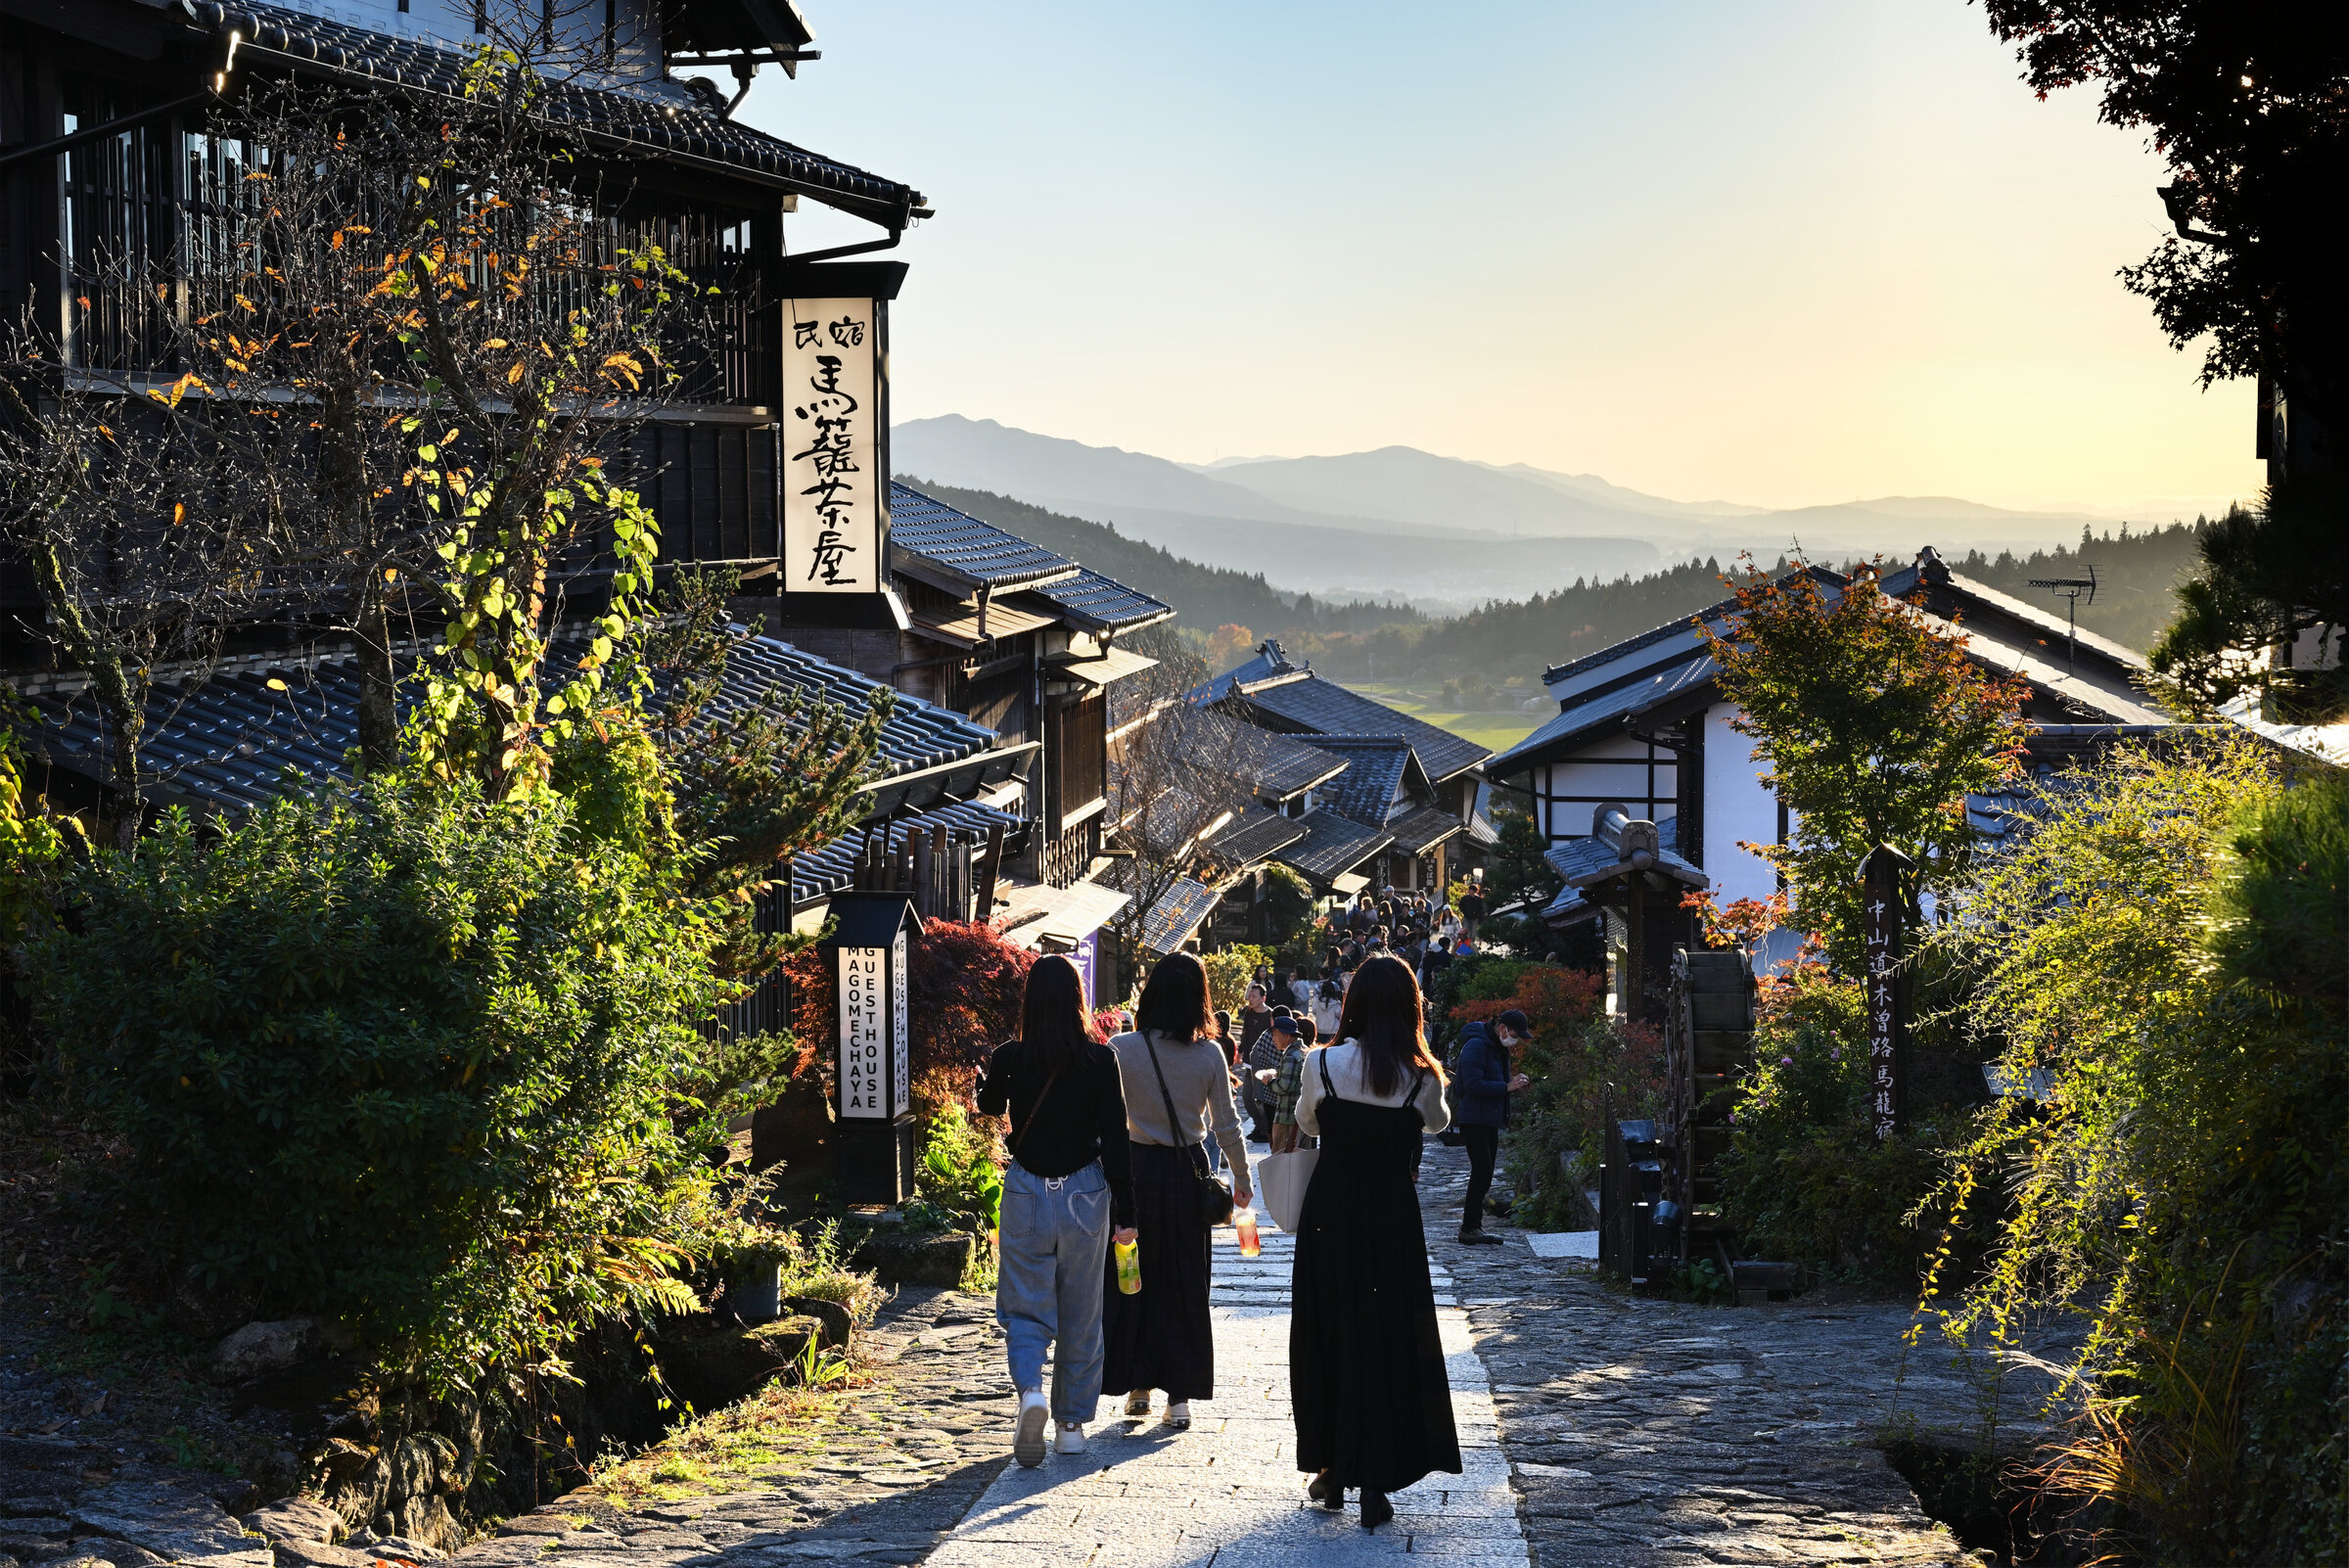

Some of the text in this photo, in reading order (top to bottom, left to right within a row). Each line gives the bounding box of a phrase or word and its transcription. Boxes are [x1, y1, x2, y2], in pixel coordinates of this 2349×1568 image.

[793, 315, 865, 349] 民宿
[791, 354, 860, 586] 馬籠茶屋
[848, 946, 869, 1108] MAGOMECHAYA
